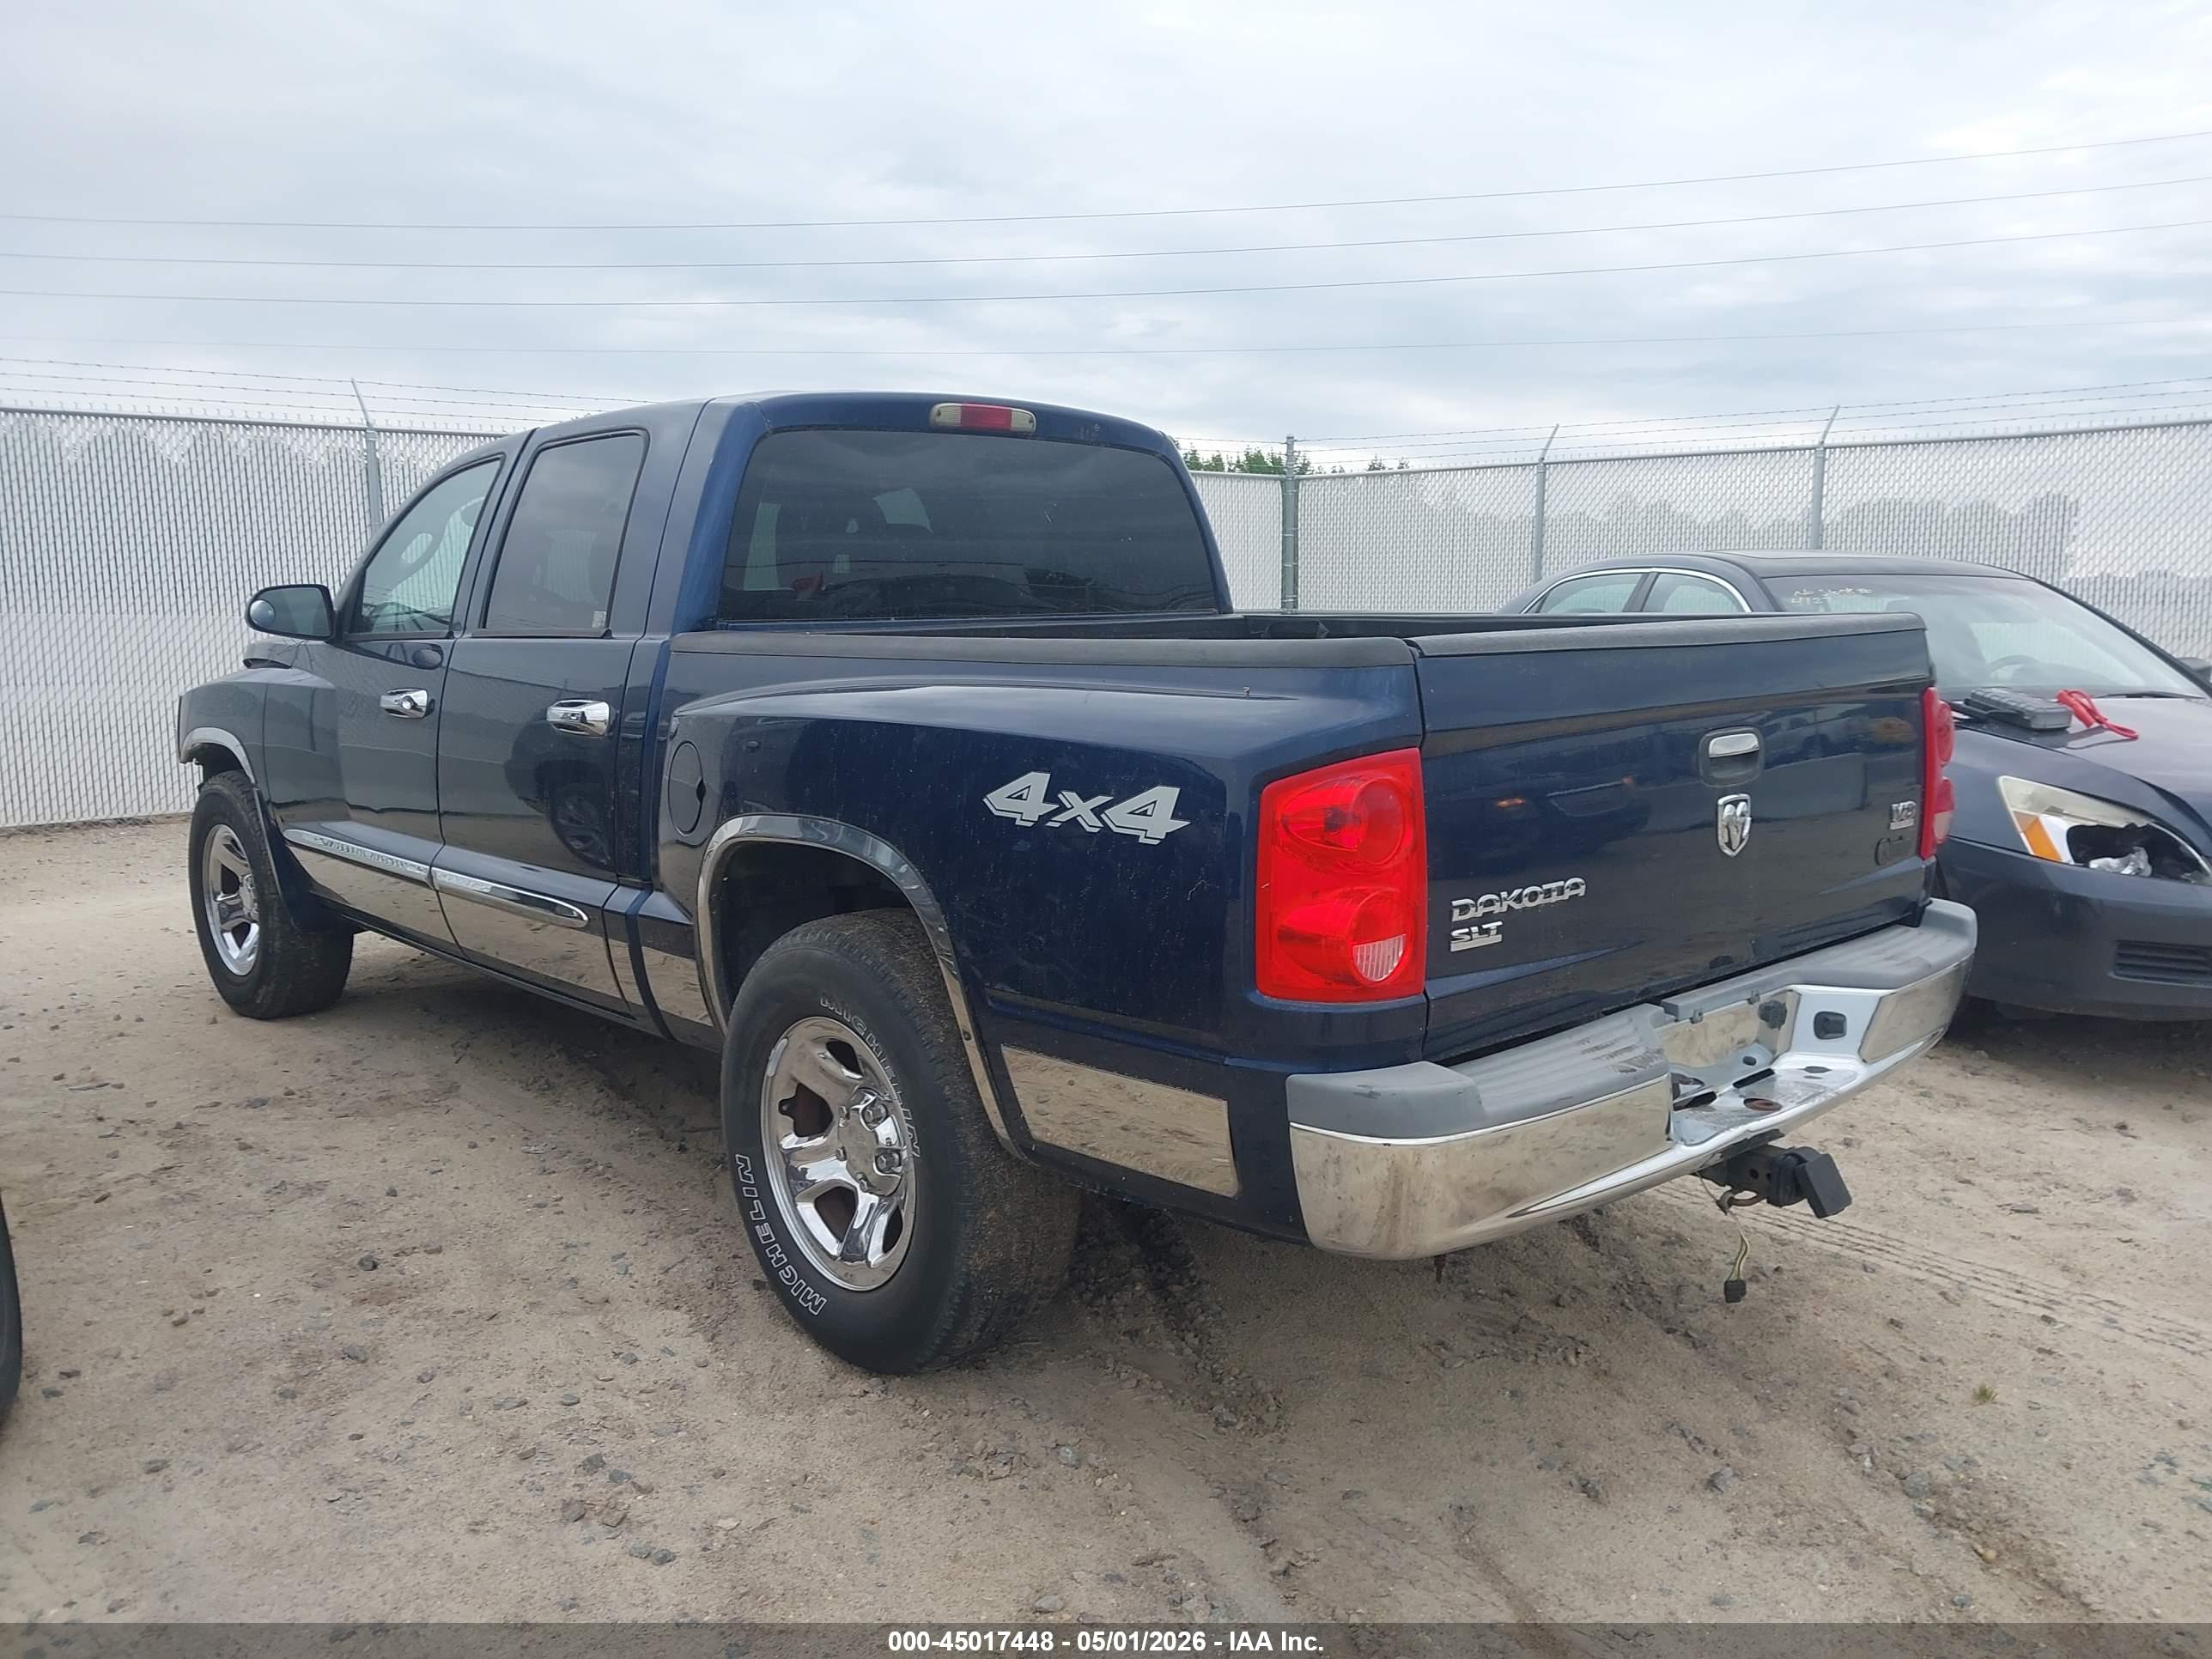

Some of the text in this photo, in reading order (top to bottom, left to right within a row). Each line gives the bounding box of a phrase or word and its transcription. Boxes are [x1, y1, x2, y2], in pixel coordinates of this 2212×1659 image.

[982, 771, 1192, 846] 4x4
[1450, 877, 1587, 923] DAKOTA
[1449, 921, 1504, 946] SLT
[734, 1153, 828, 1316] MICHELIN
